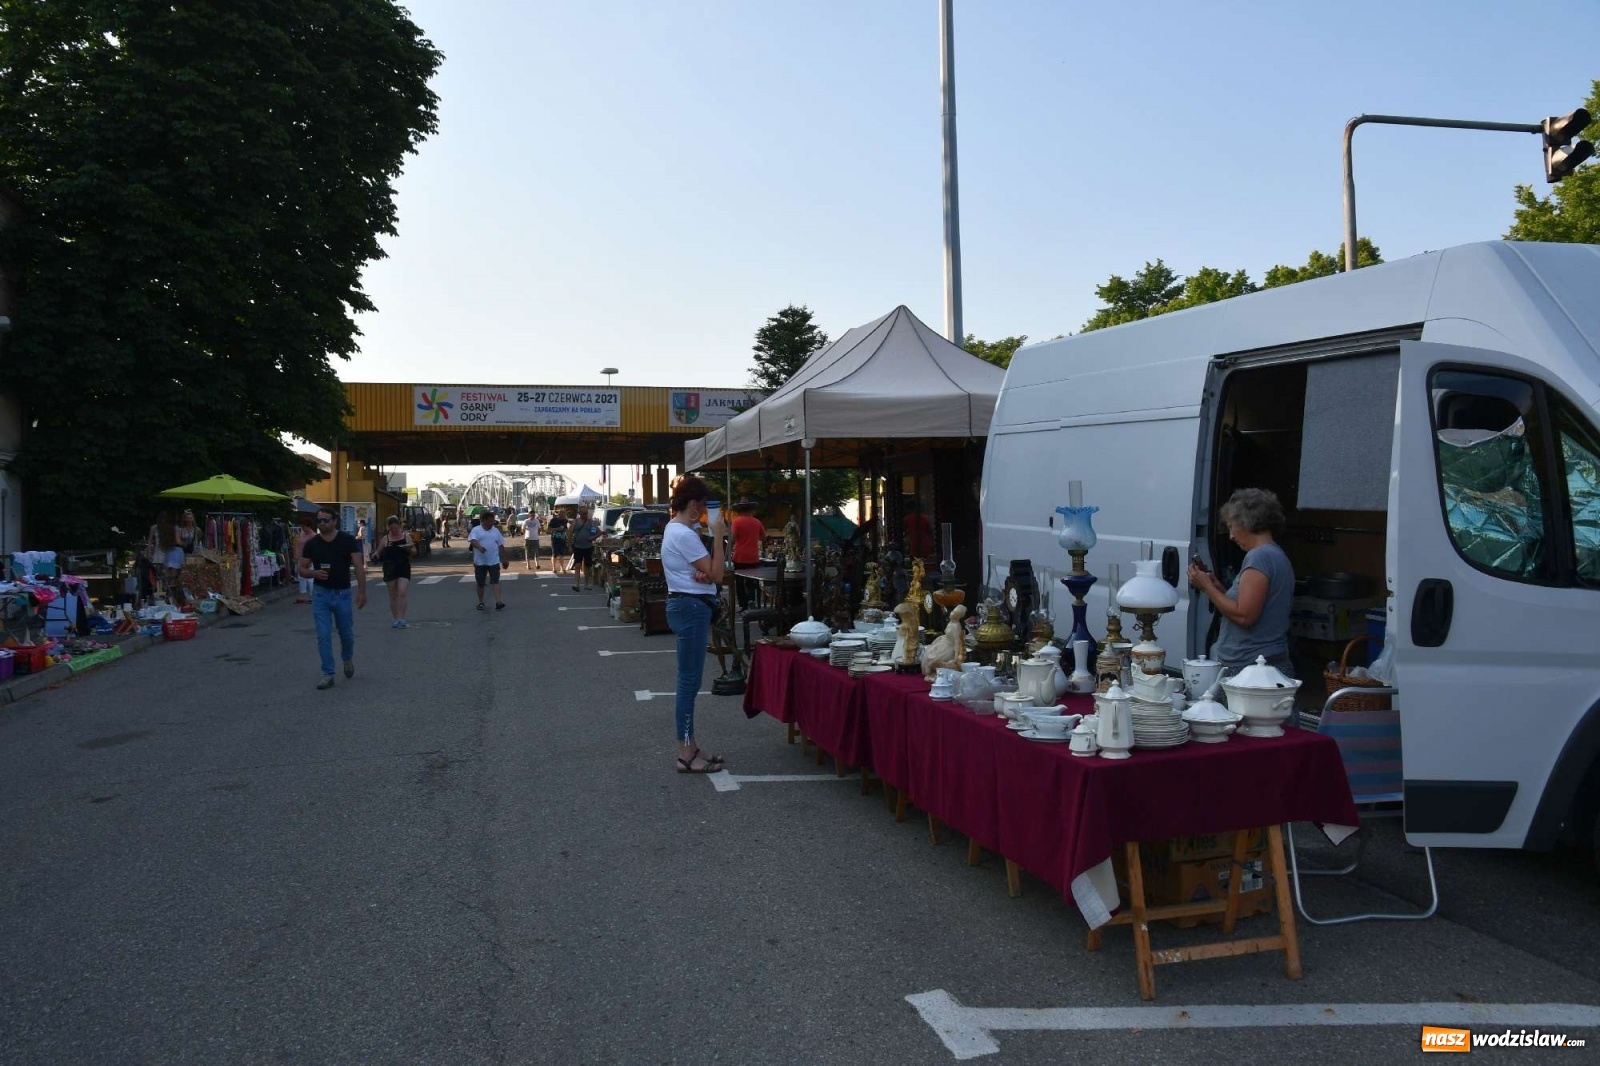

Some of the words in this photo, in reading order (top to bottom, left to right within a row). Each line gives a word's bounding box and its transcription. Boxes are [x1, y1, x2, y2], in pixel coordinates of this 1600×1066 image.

[460, 392, 509, 402] FESTIWAL
[517, 392, 546, 403] 25-27
[548, 392, 593, 404] CZERWCA
[594, 393, 618, 404] 2021
[705, 398, 754, 407] JARMAR
[534, 406, 570, 414] ZAPRASZAMY
[571, 406, 580, 414] NA
[580, 406, 602, 414] POKŁAD
[460, 412, 488, 422] ODRY
